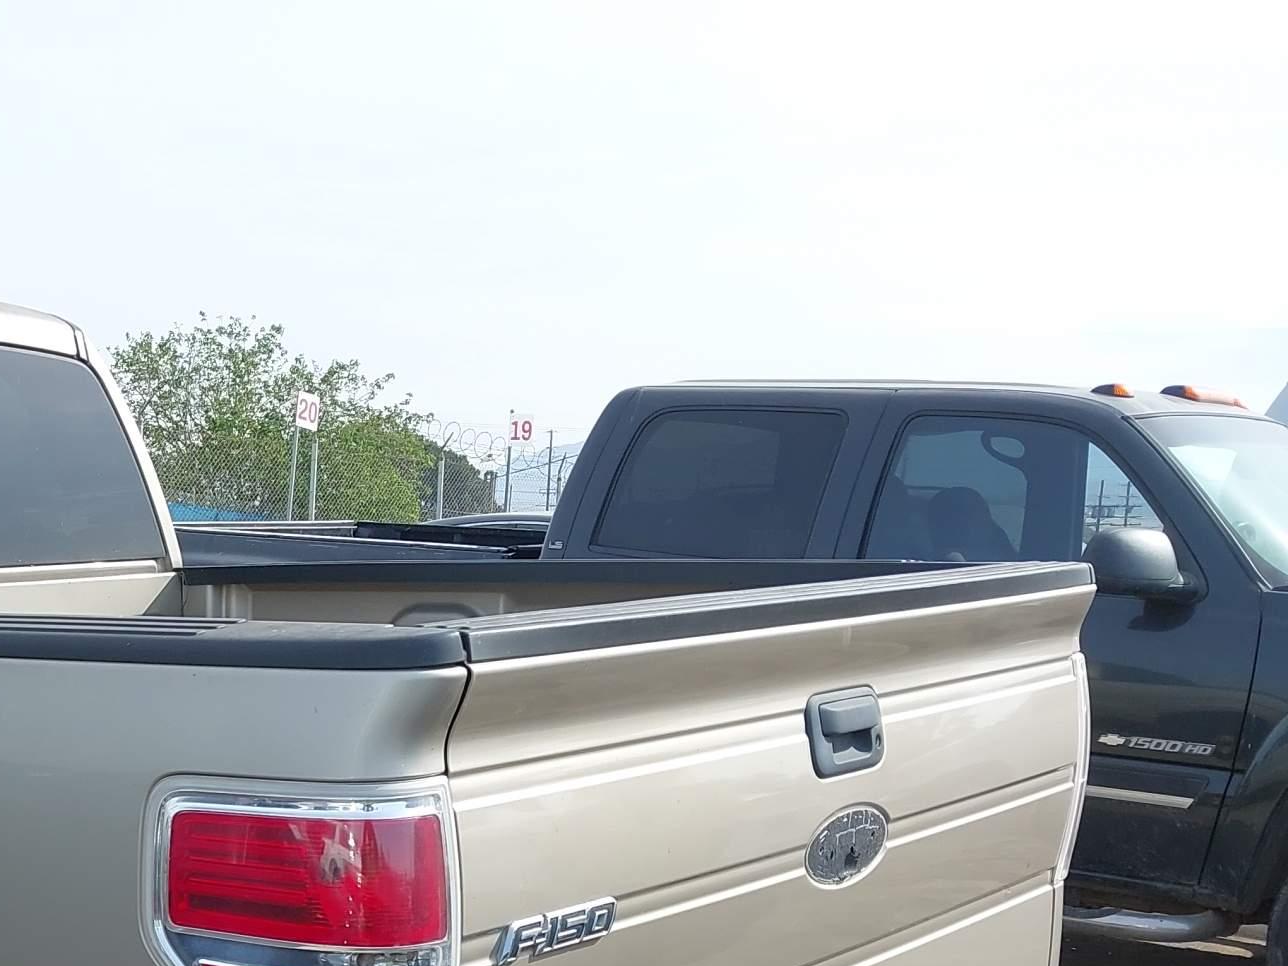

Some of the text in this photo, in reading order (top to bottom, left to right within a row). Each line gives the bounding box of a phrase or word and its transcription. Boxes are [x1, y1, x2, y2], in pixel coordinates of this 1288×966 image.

[298, 398, 318, 424] 20
[510, 420, 533, 441] 19
[491, 896, 617, 966] F-150
